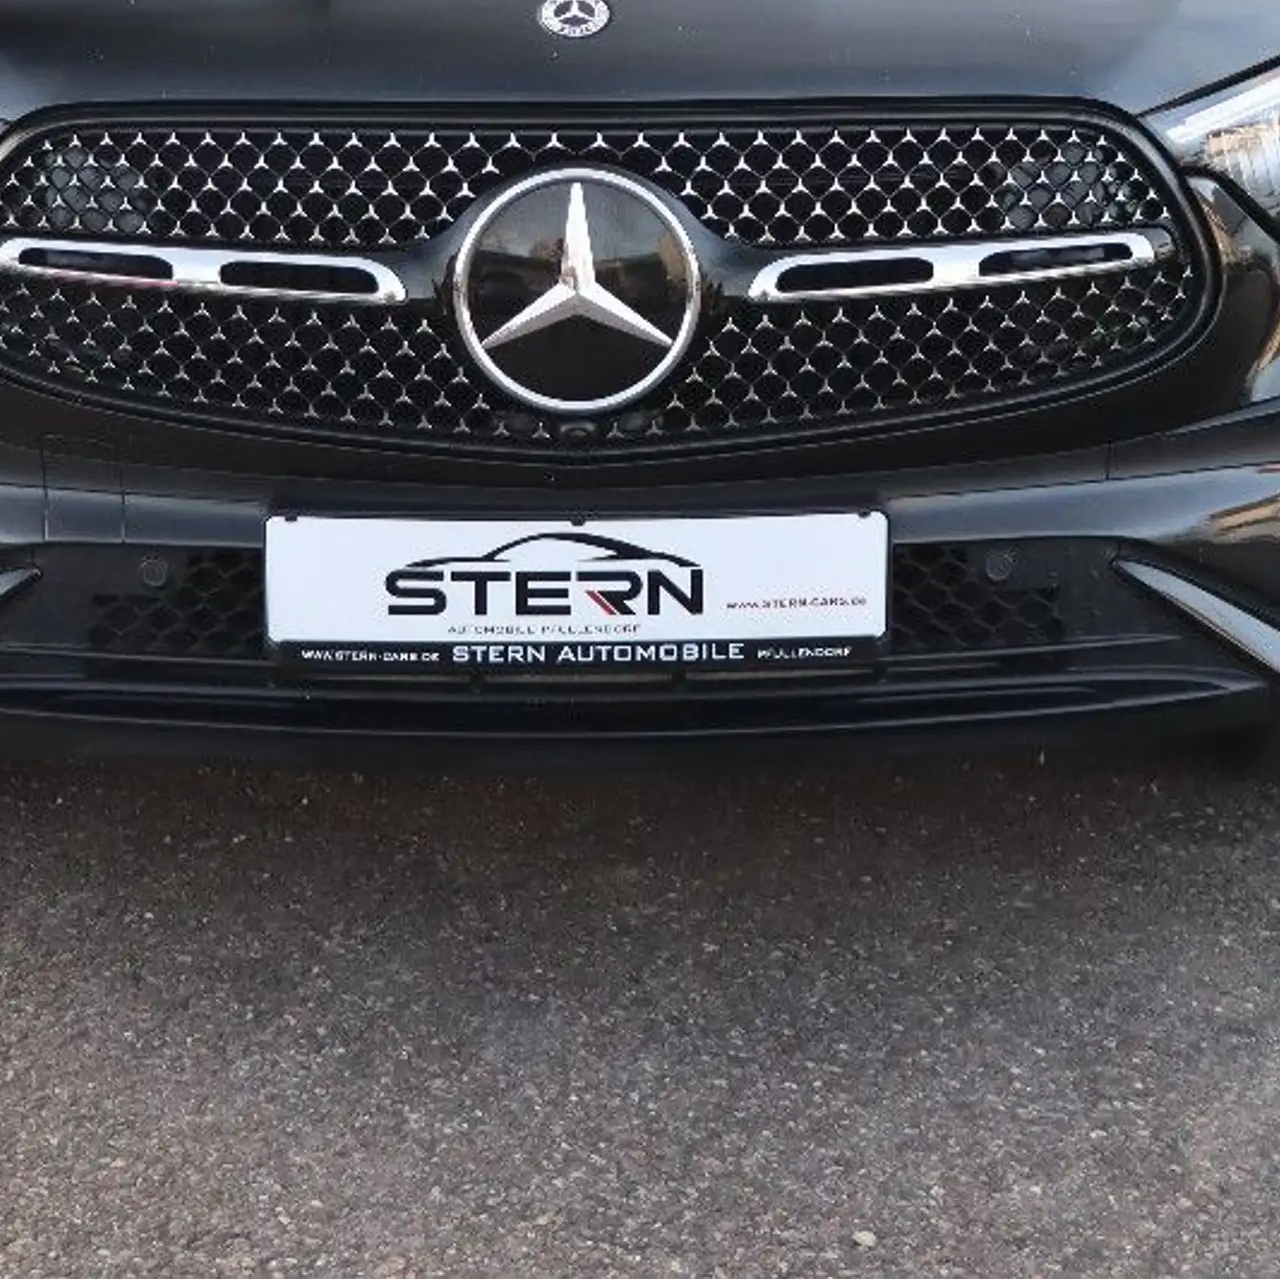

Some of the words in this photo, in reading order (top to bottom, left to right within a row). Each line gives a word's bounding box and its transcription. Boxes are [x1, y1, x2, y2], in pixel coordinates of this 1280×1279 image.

[385, 569, 704, 616] STERN
[452, 644, 546, 663] STERN
[557, 642, 745, 662] AUTOMOBILE
